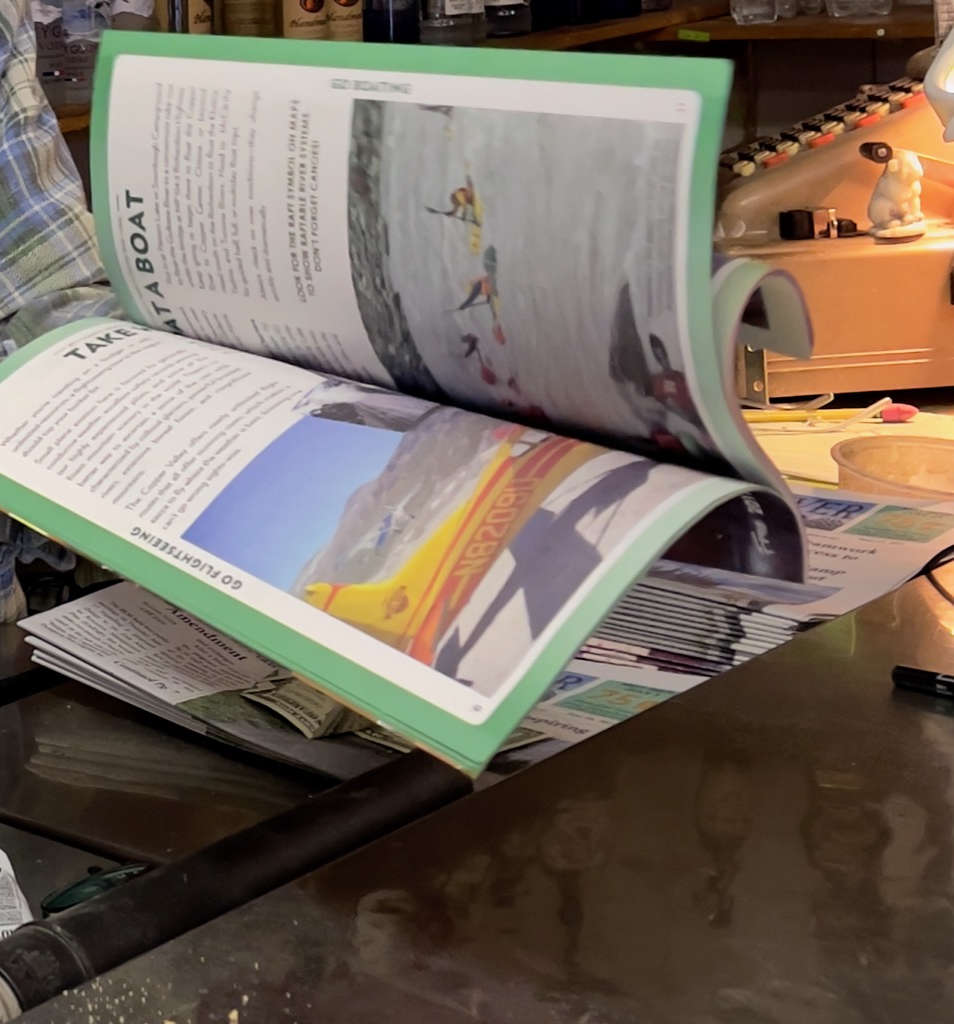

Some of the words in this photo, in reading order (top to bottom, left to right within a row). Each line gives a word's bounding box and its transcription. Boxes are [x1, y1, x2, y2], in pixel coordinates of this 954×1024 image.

[287, 157, 295, 200] SYMBOL
[287, 203, 295, 228] RAFT
[299, 197, 307, 246] RAFTABLE
[310, 195, 318, 236] FORGET
[125, 189, 155, 274] BOAT
[288, 232, 296, 248] THE
[291, 252, 299, 272] FOR
[302, 250, 312, 280] SHOW
[312, 240, 322, 272] DON'T
[144, 281, 165, 298] A
[294, 276, 306, 303] LOOK
[307, 284, 316, 296] TO
[62, 328, 138, 360] TAKE
[130, 526, 222, 579] FLIGHTSEEING
[221, 574, 243, 590] GO
[164, 605, 248, 662] Amendment
